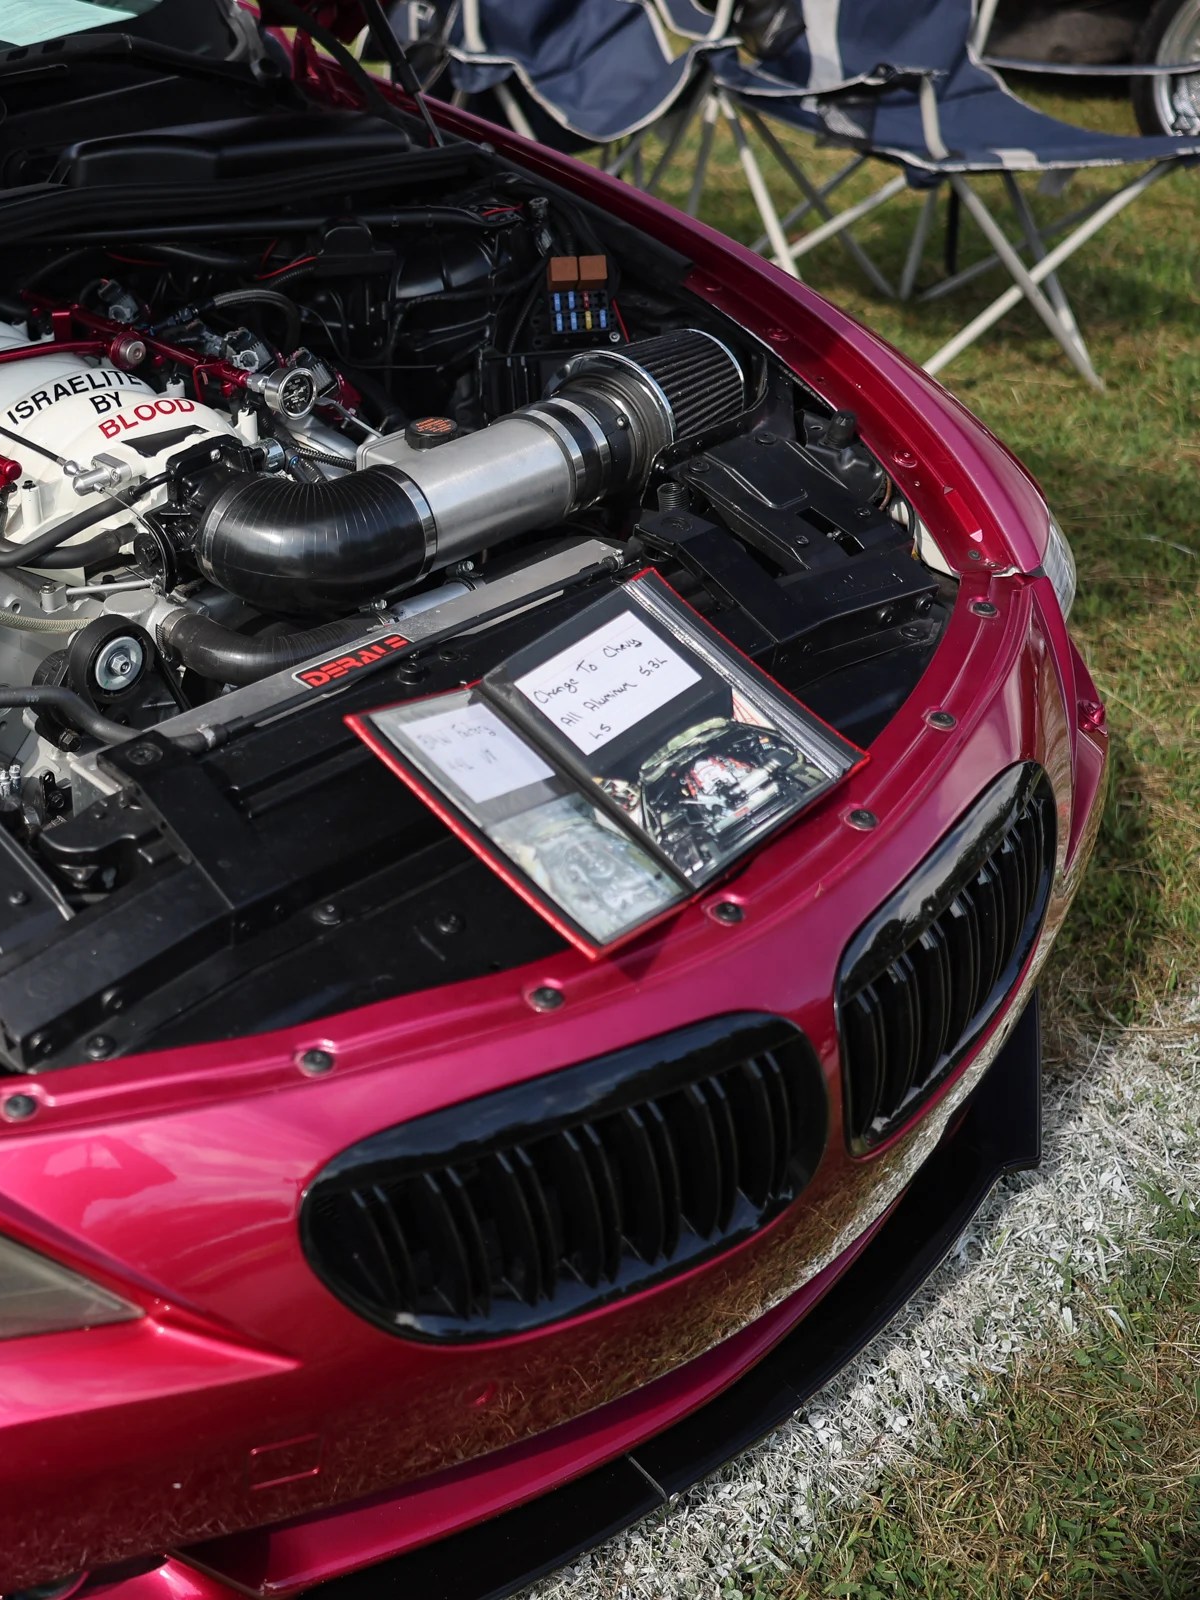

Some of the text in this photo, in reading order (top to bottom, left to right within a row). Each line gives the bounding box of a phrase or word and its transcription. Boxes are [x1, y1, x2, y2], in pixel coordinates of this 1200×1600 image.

[6, 370, 144, 426] ISRAELITE
[89, 391, 123, 415] BY
[98, 399, 195, 440] BLOOD
[575, 659, 598, 674] To
[602, 638, 643, 658] Chevy
[560, 711, 584, 727] All
